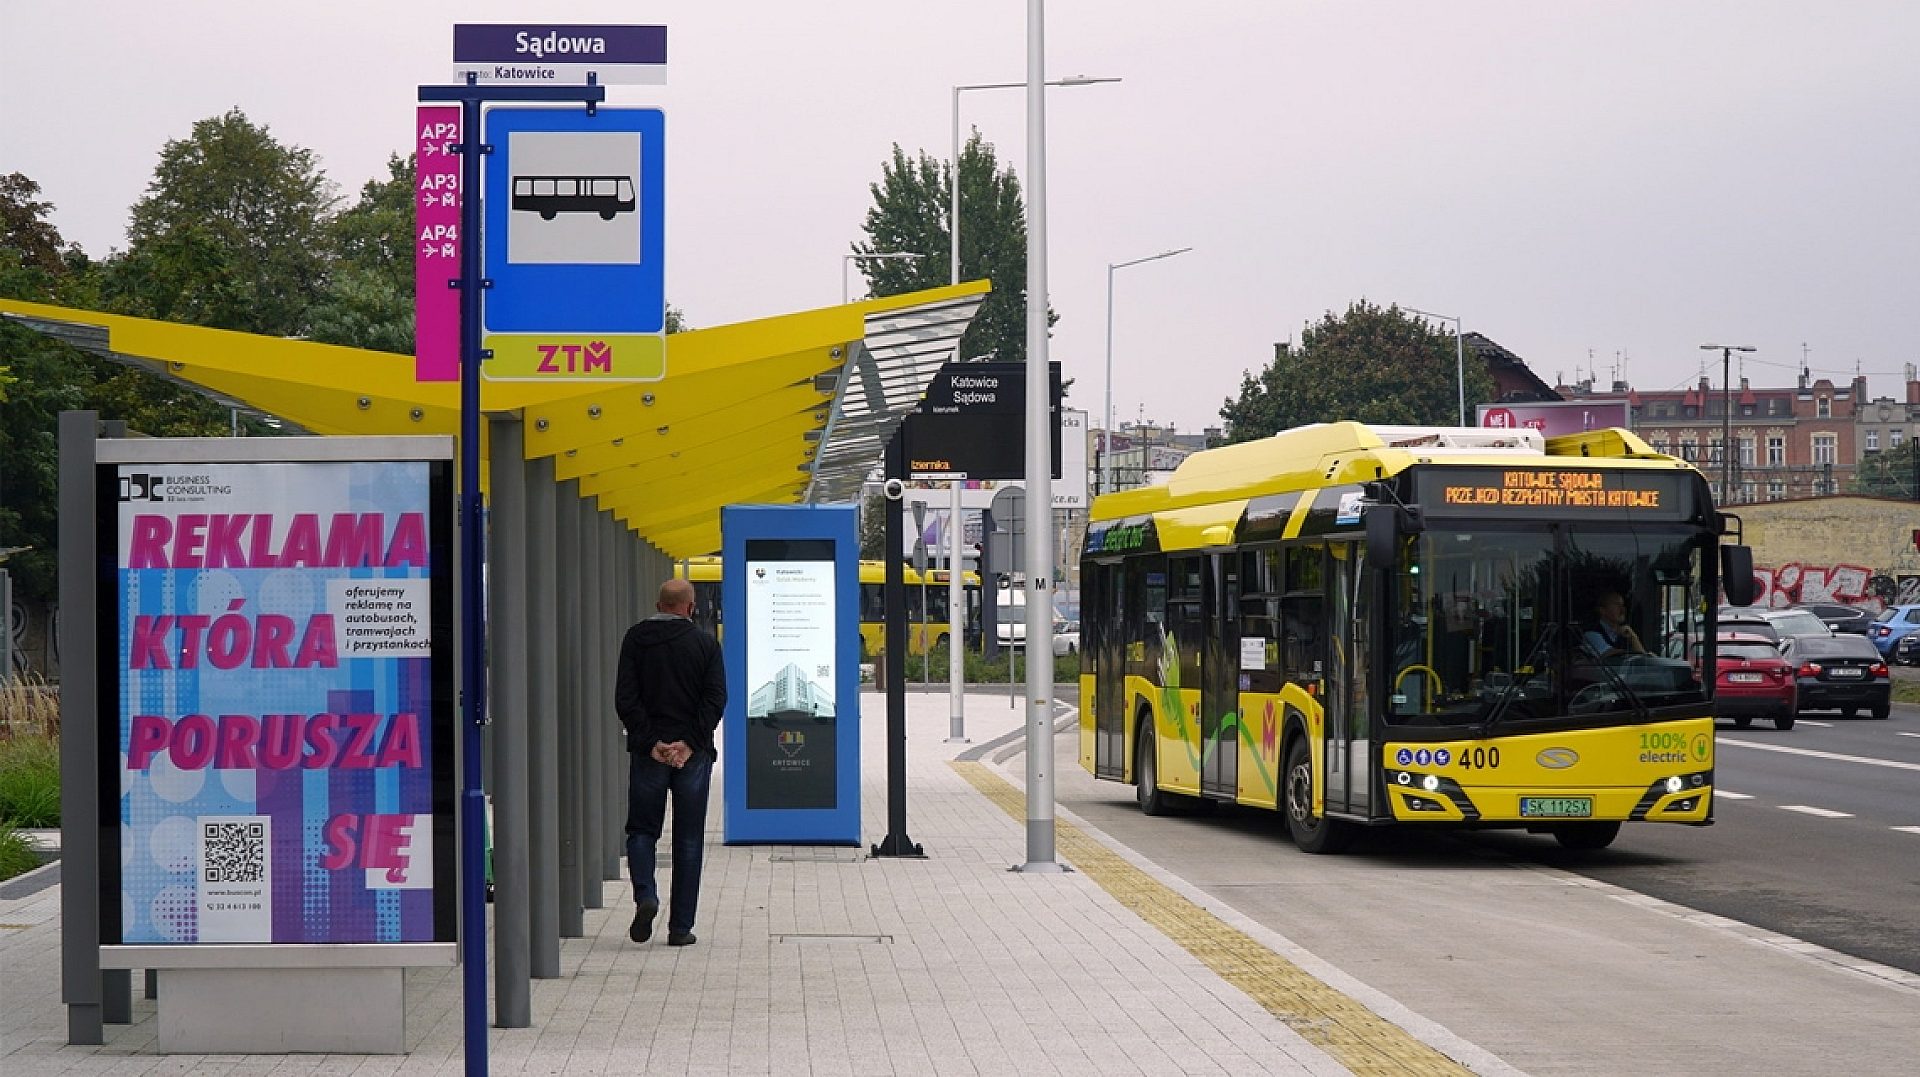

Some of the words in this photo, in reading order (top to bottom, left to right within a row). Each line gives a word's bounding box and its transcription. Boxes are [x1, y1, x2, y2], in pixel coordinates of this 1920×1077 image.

[515, 31, 606, 58] Sądowa
[494, 65, 555, 79] Katowice
[420, 123, 457, 140] AP2
[420, 173, 457, 190] AP3
[420, 224, 458, 241] AP4
[536, 340, 613, 374] ZTM
[951, 375, 999, 389] Katowice
[953, 391, 997, 406] Sądowa
[166, 475, 210, 485] BUSINESS
[1503, 472, 1556, 488] KATOWICE
[166, 485, 232, 495] CONSULTING
[1607, 491, 1660, 507] KATOWICE
[128, 512, 428, 569] REKLAMA
[1035, 577, 1047, 590] M
[345, 586, 405, 600] oferujemy
[345, 599, 393, 611] reklamę
[396, 601, 412, 610] na
[345, 611, 417, 625] autobusach,
[129, 597, 339, 671] KTÓRA
[346, 625, 416, 639] tramwajach
[345, 639, 350, 650] i
[127, 712, 423, 771] PORUSZA
[1639, 732, 1687, 750] 100%
[1458, 746, 1500, 770] 400
[1639, 749, 1687, 763] electric
[1528, 800, 1545, 814] SK
[317, 813, 415, 884] SIĘ
